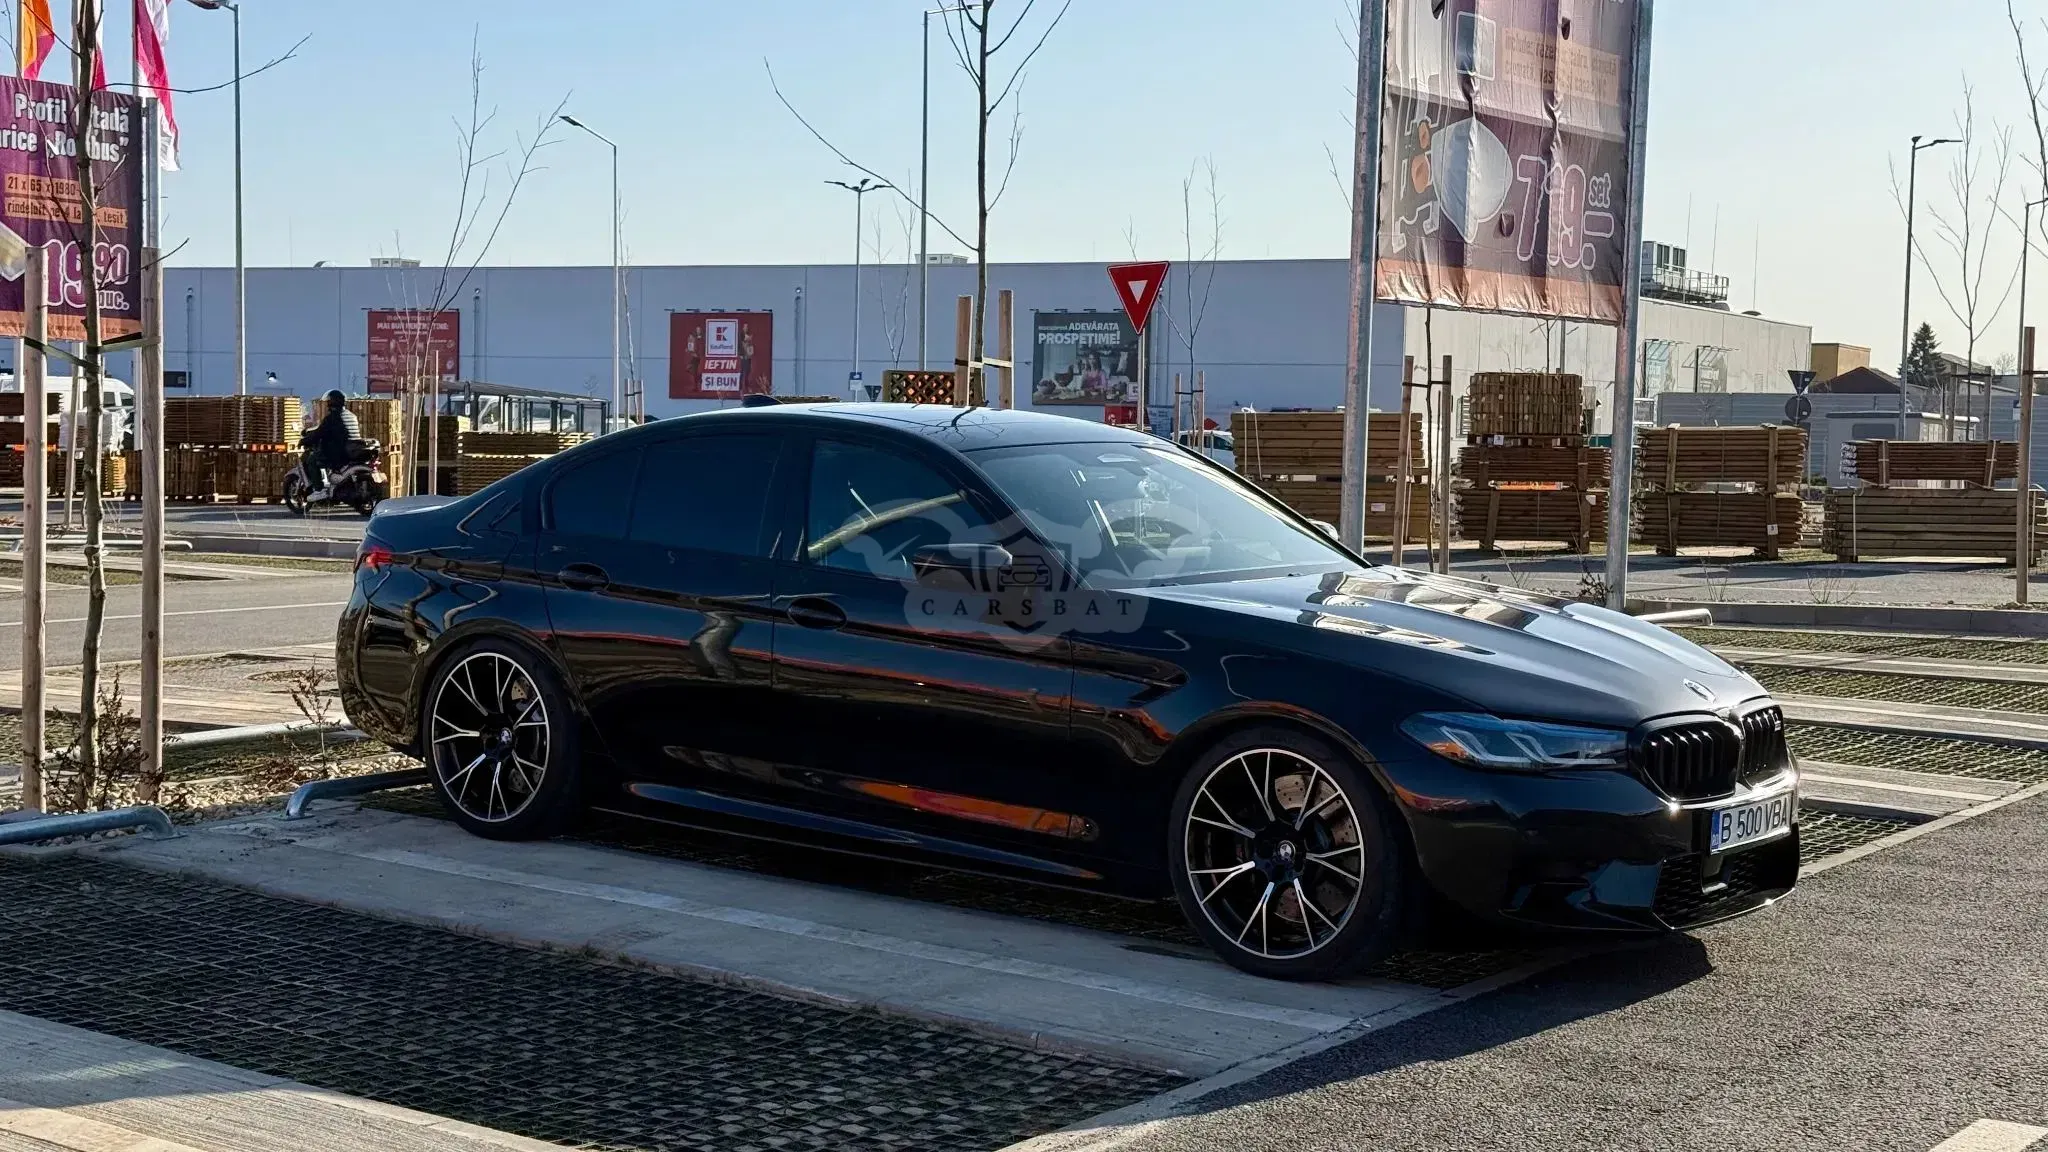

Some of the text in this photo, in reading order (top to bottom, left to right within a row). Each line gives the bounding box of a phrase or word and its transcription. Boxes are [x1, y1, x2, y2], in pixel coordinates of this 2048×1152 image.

[14, 92, 67, 124] Profil
[0, 123, 37, 152] rice
[7, 176, 18, 190] 21
[30, 178, 42, 192] 65
[1038, 330, 1121, 347] PROSPEȚIME!
[704, 359, 738, 370] IEFTIN
[716, 376, 737, 387] BUN
[1720, 812, 1733, 844] B
[1736, 805, 1763, 839] 500
[1765, 799, 1787, 833] VBA
